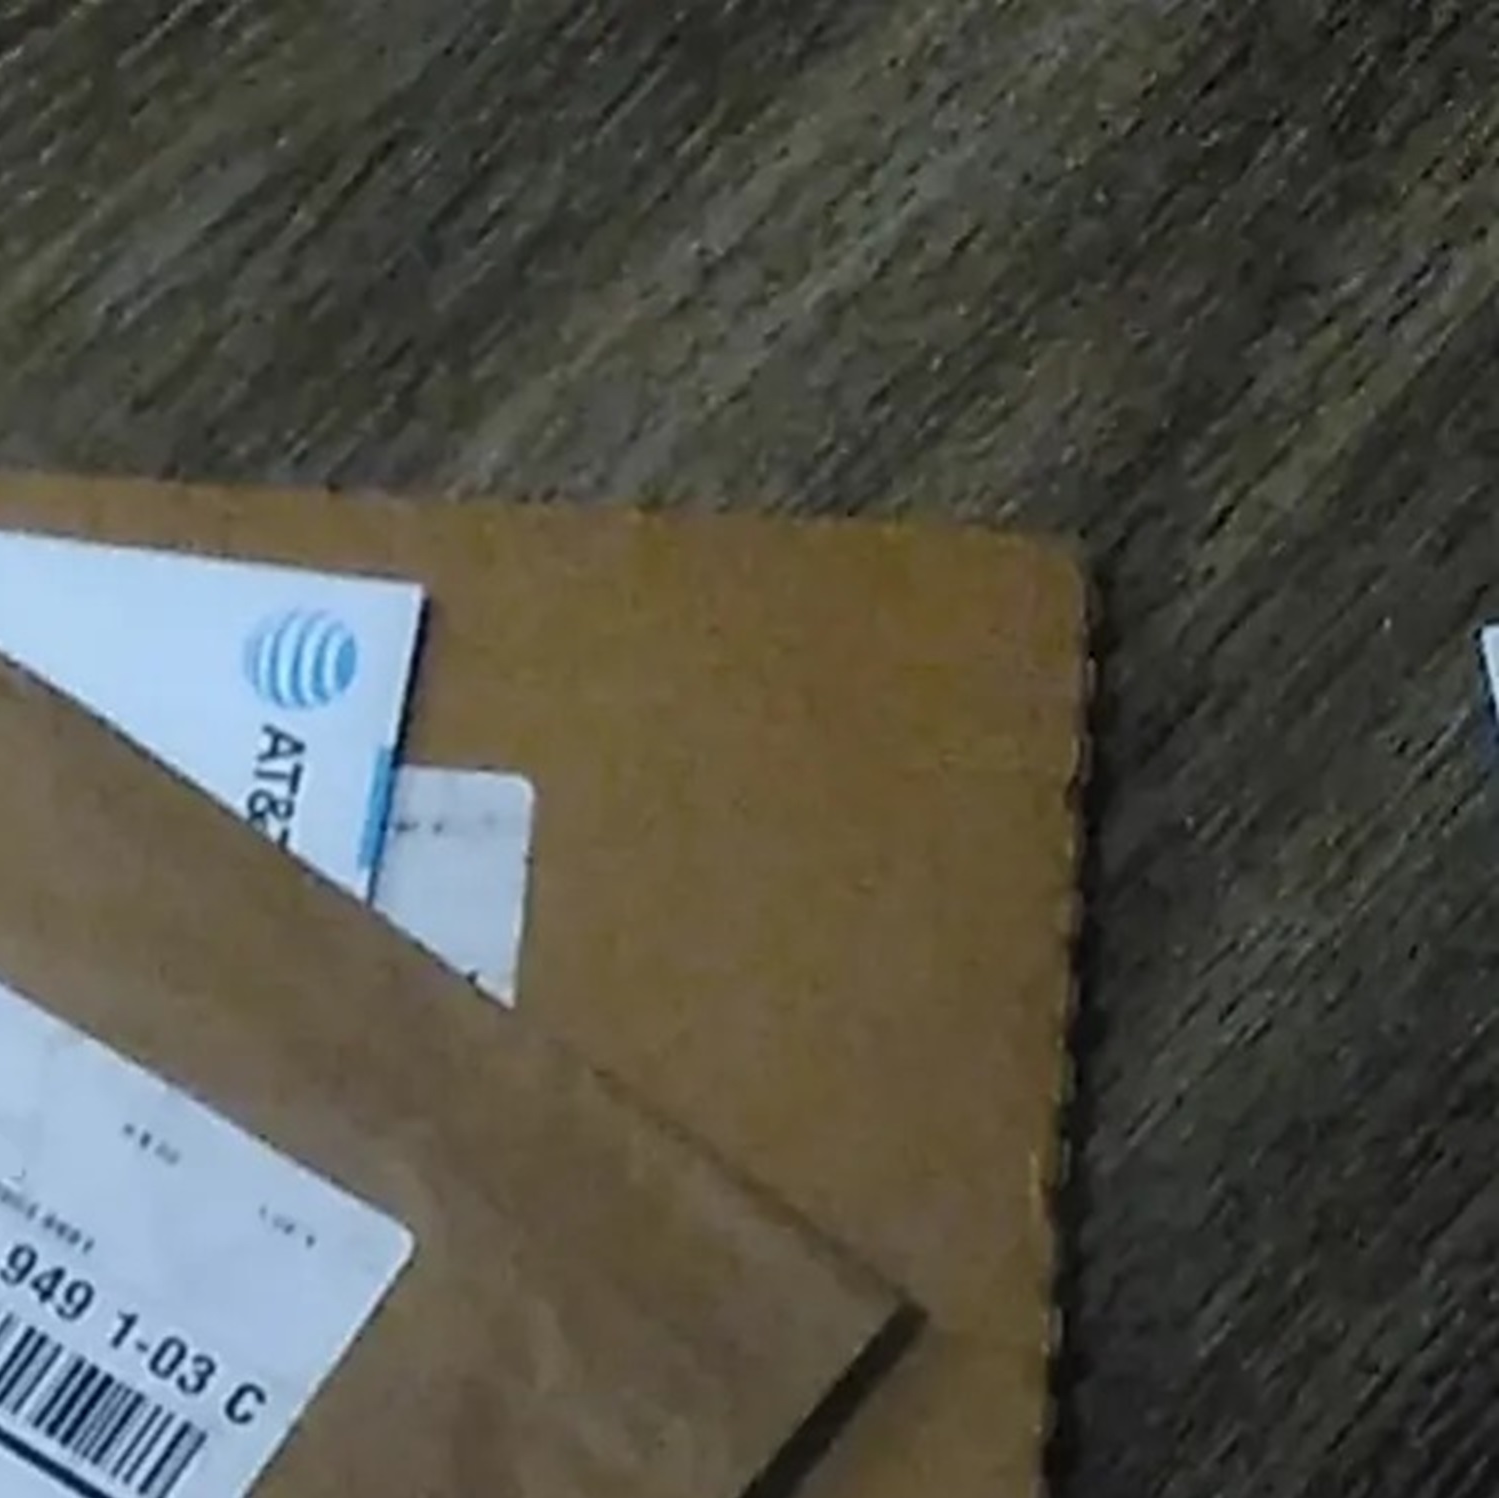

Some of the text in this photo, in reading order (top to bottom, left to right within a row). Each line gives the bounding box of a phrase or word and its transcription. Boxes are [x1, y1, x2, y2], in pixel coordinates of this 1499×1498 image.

[246, 723, 305, 853] AT&
[106, 1310, 219, 1396] 1-03
[223, 1381, 268, 1427] C
